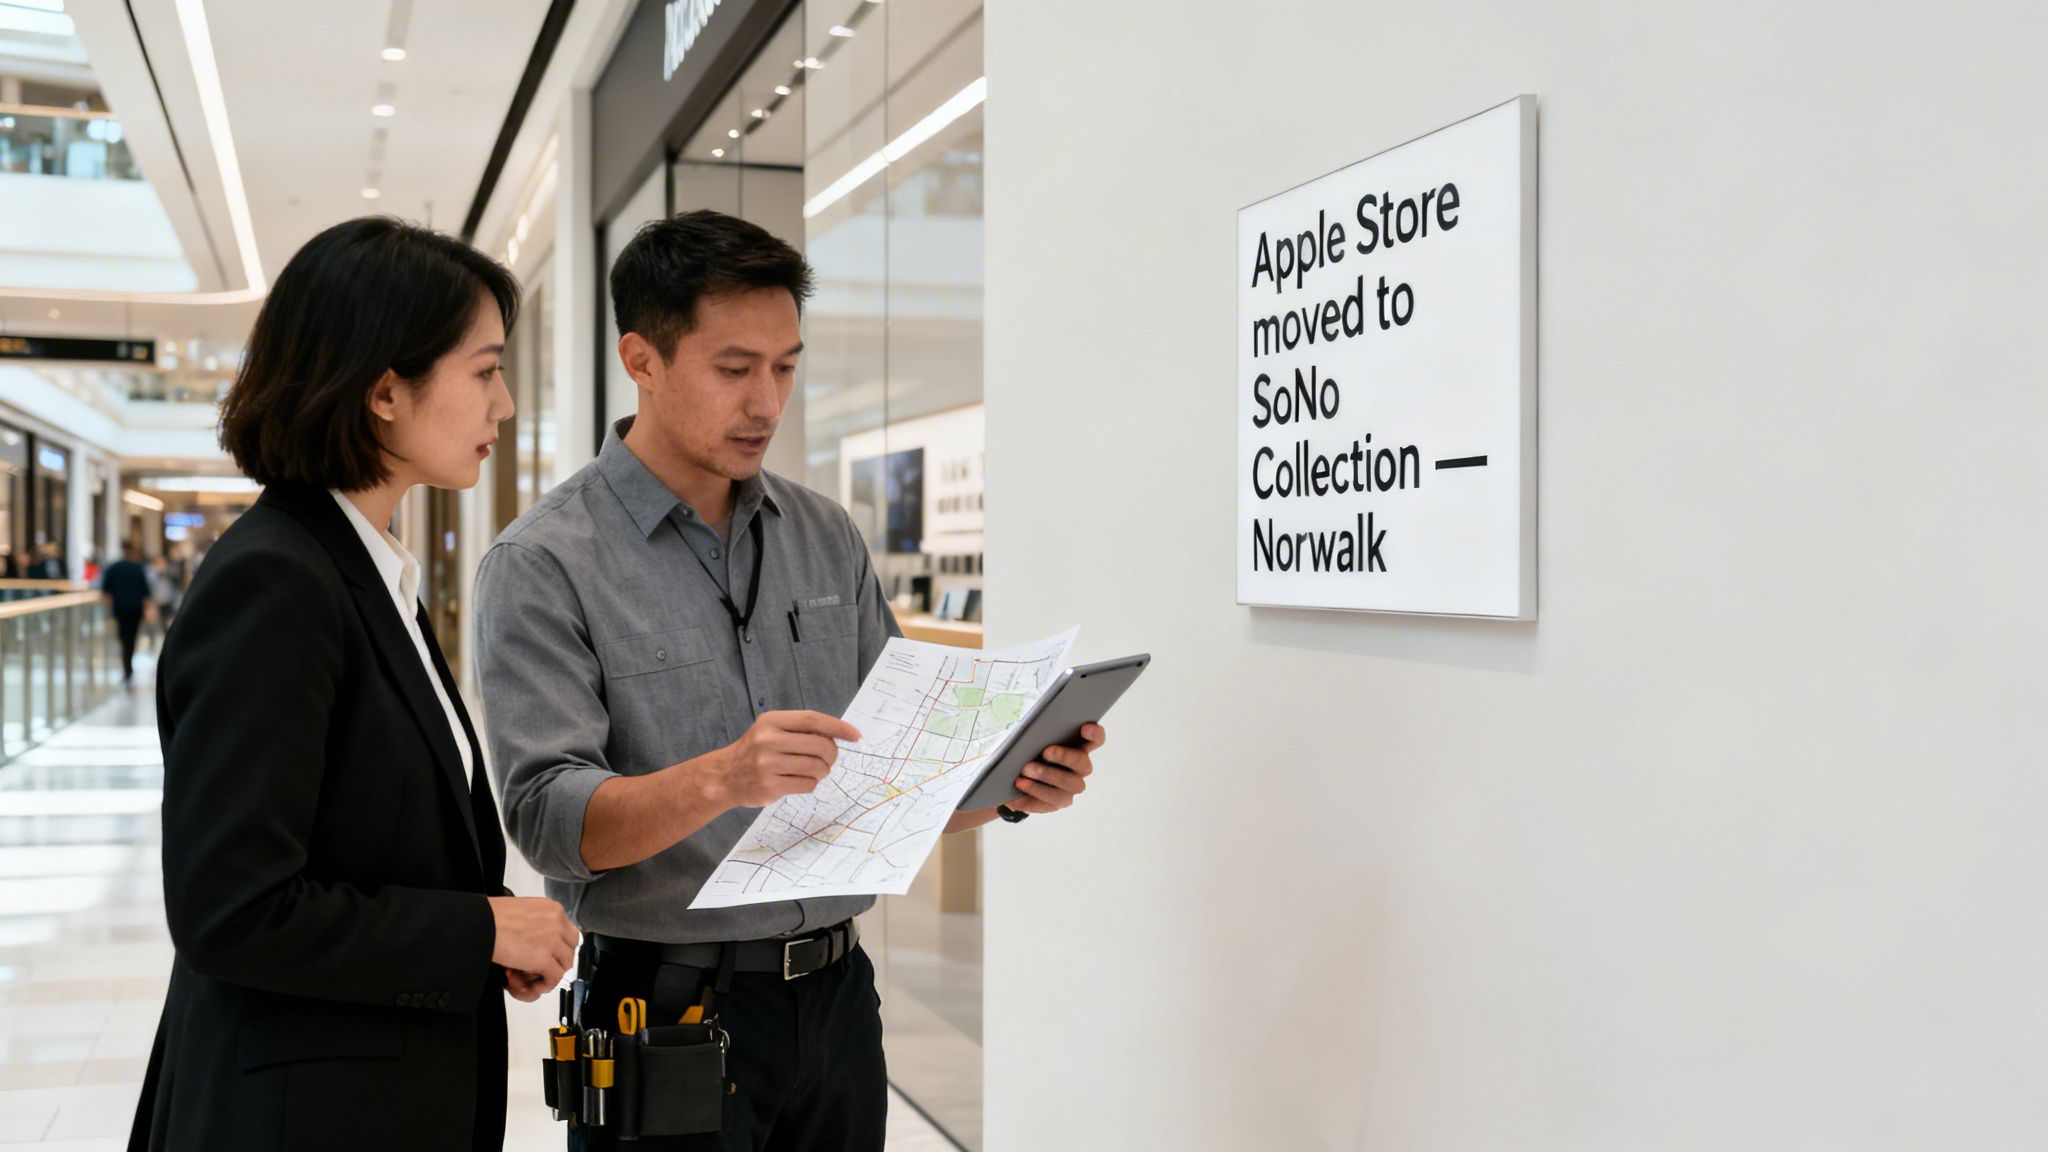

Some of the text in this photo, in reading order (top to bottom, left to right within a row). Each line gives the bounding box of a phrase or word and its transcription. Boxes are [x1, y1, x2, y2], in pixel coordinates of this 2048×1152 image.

[1251, 182, 1460, 295] Apple Store
[1252, 274, 1415, 358] moved to
[1252, 365, 1340, 429] SoNo
[1252, 432, 1420, 500] Collection
[1253, 511, 1387, 573] Norwalk
